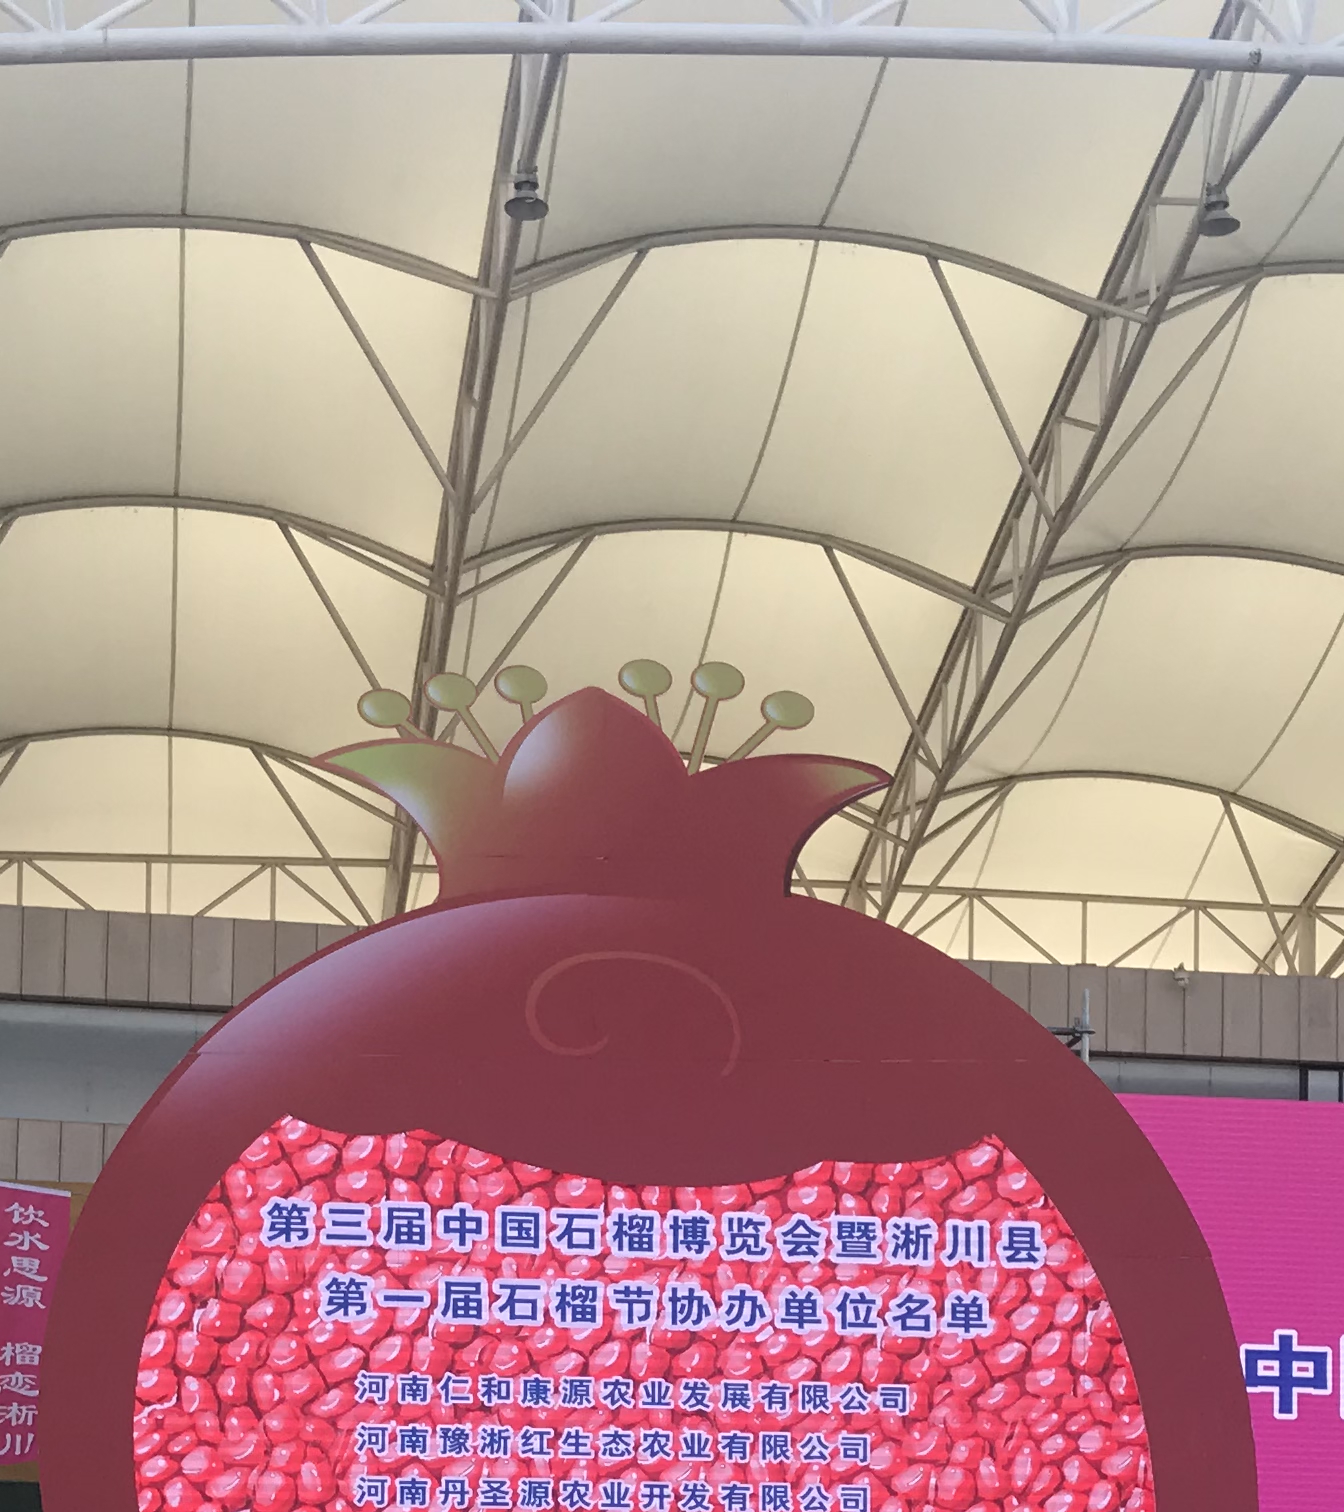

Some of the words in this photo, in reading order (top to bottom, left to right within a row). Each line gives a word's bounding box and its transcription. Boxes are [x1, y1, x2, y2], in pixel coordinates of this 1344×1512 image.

[1, 1201, 51, 1310] 饮水思源
[264, 1200, 1044, 1267] 第三届中国石榴博览会暨淅川县
[324, 1278, 991, 1335] 第一届石榴节协办单位名单
[357, 1373, 912, 1415] 河南仁和康源农业发展有限公司
[355, 1425, 872, 1465] 河南豫淅红生态农业有限公司
